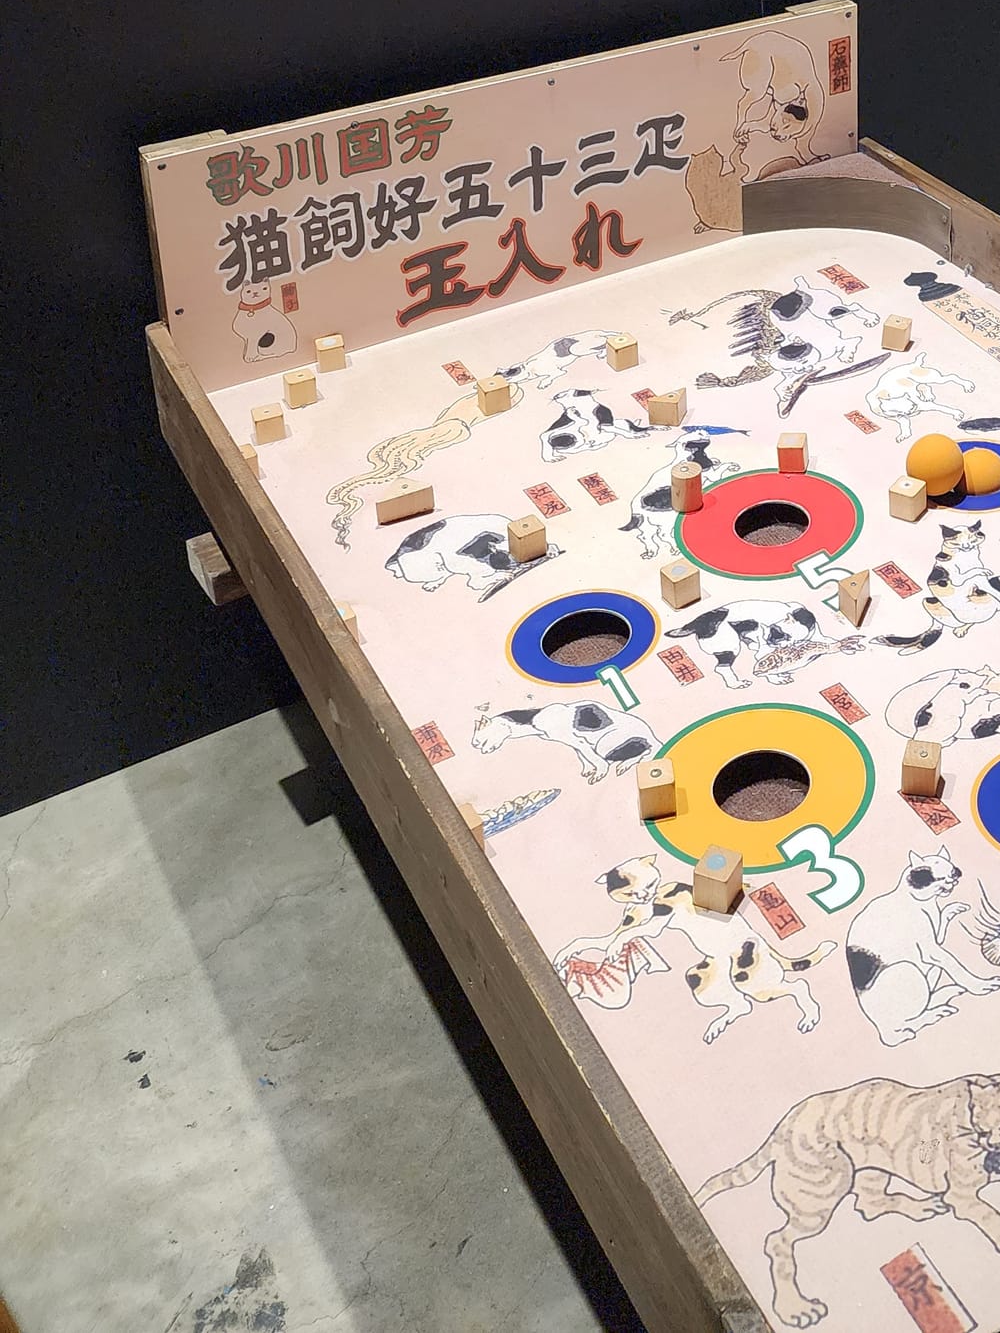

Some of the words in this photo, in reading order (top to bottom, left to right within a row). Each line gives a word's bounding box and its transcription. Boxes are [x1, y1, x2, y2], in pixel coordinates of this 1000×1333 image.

[205, 105, 454, 205] 歌川国芳
[396, 201, 643, 329] 玉入れ
[794, 550, 856, 612] 5
[595, 664, 640, 711] 1
[662, 651, 697, 682] 由井
[831, 691, 851, 711] 宮
[776, 824, 865, 914] 3
[896, 1263, 943, 1311] 京
